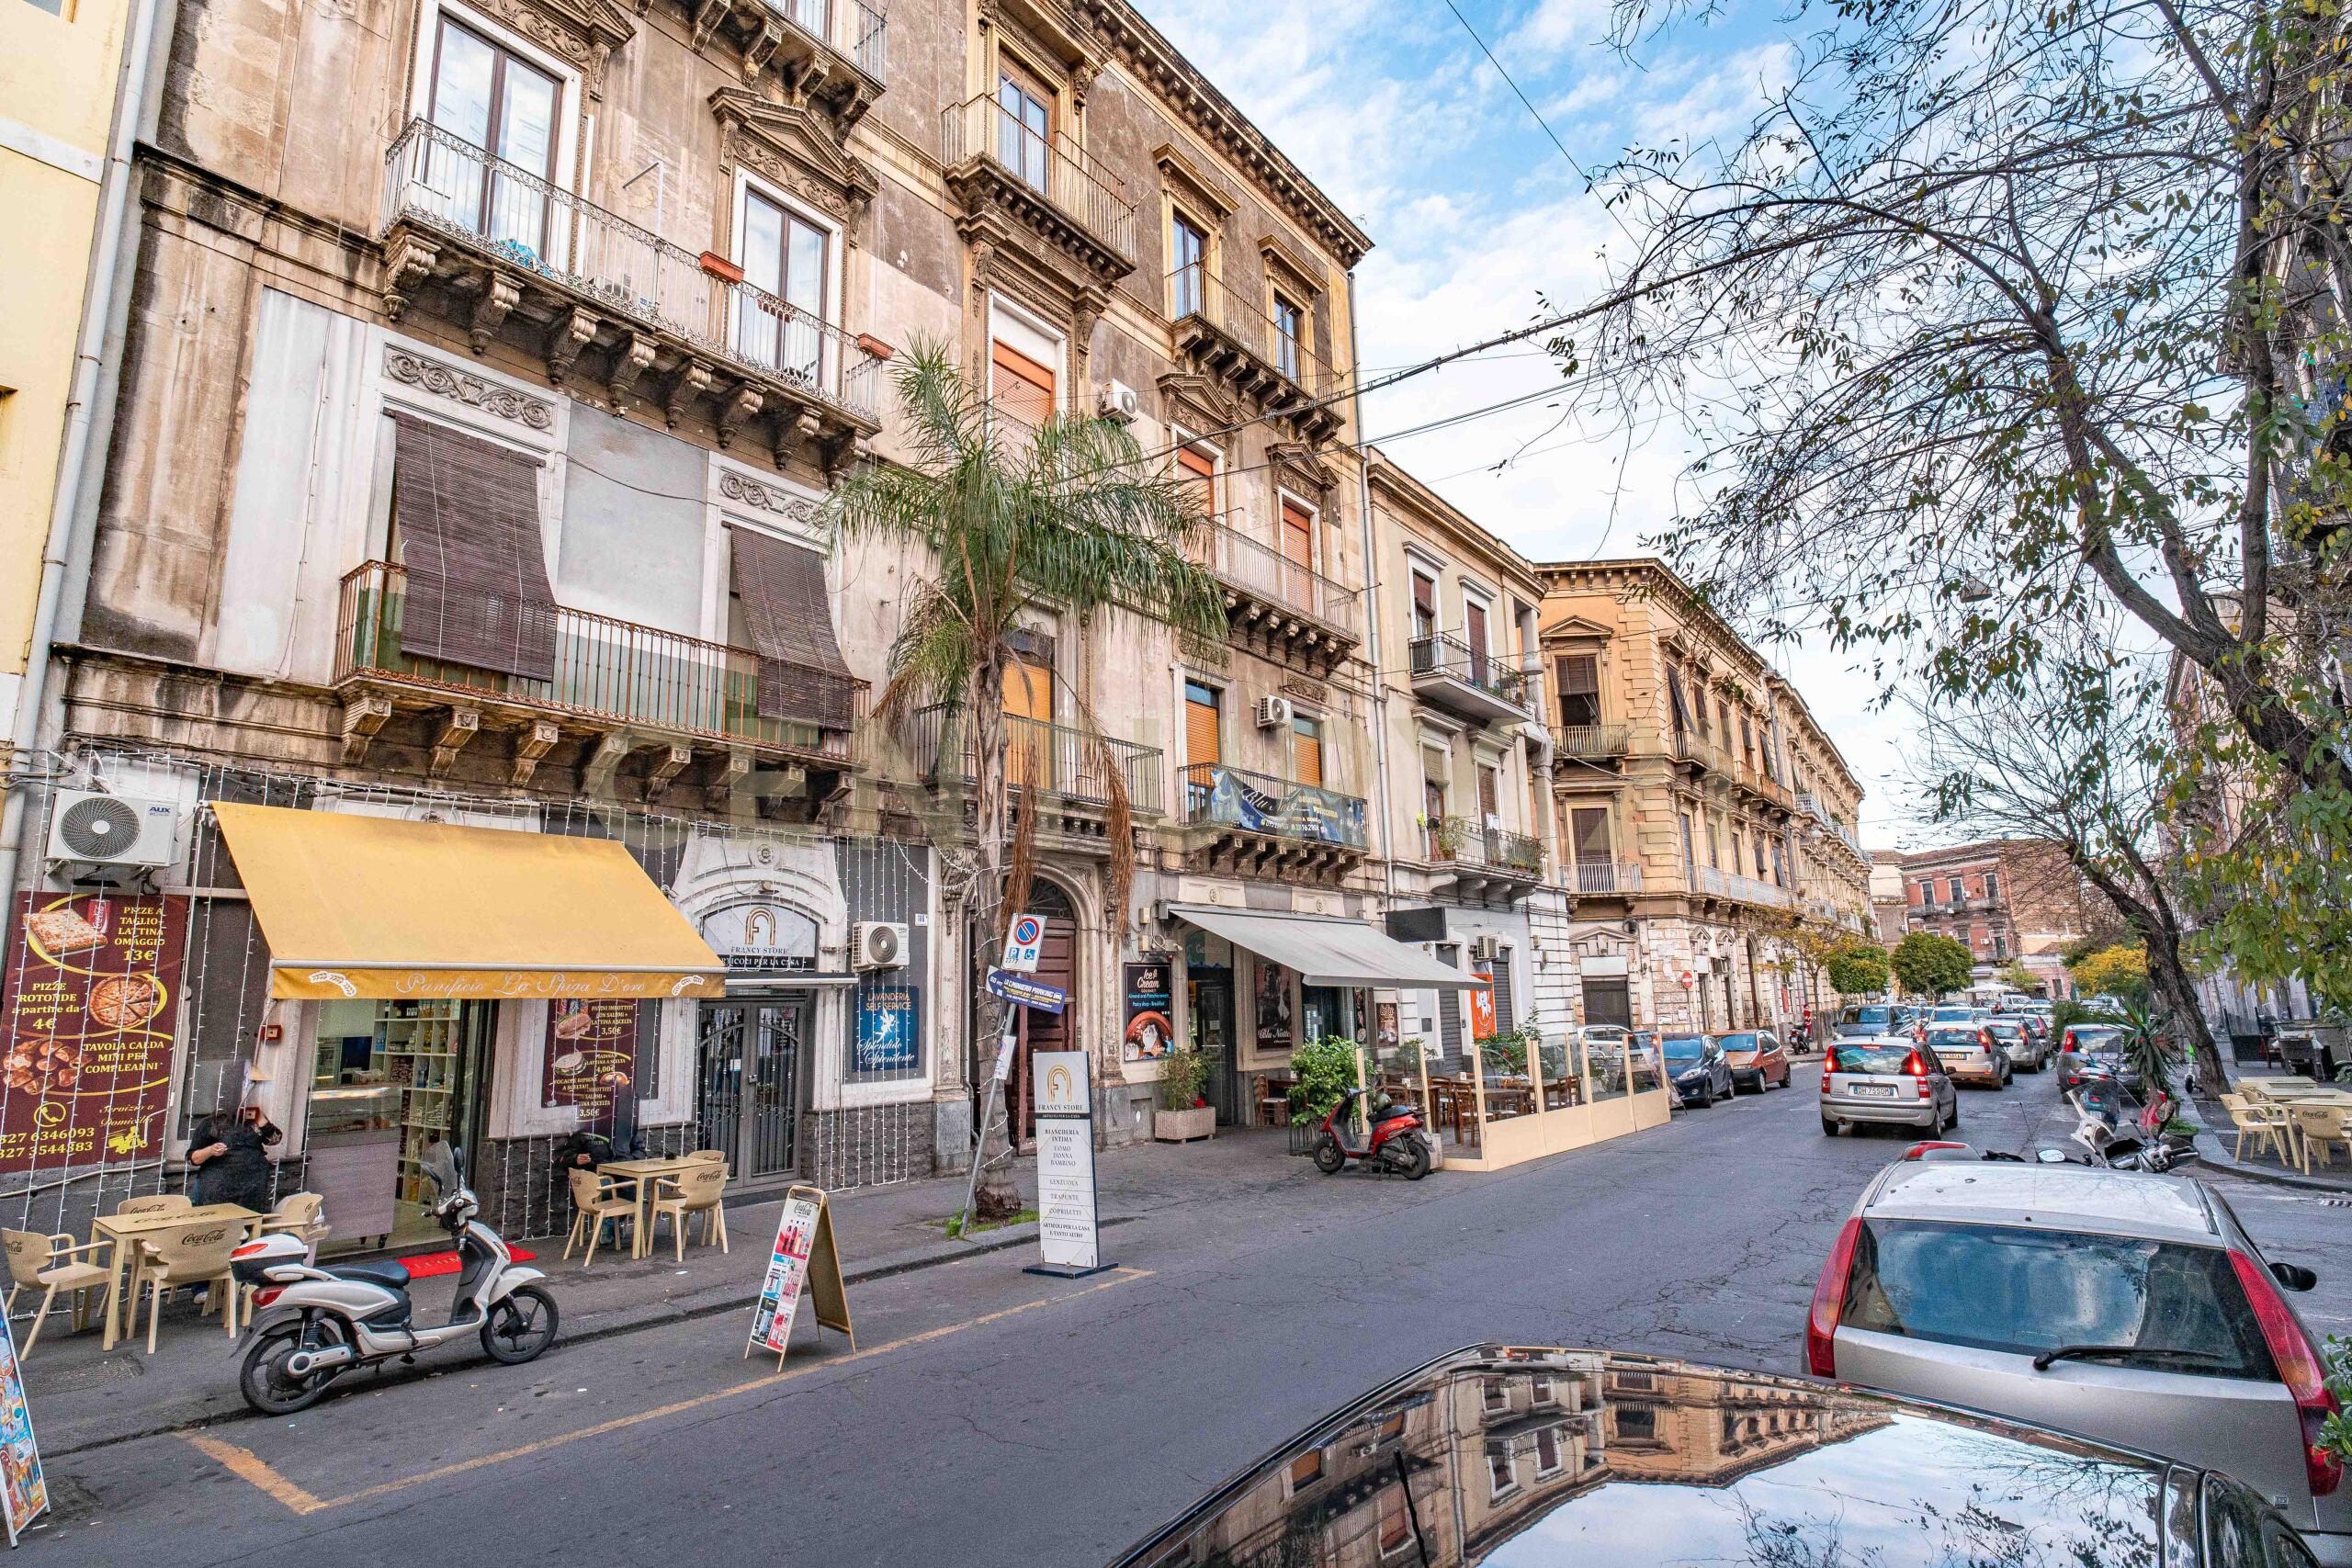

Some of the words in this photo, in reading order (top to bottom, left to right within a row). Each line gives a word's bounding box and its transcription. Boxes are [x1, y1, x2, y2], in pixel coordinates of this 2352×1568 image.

[123, 907, 154, 915] PIZZE
[119, 917, 158, 925] TAGLIO
[118, 928, 164, 936] LATTINA
[114, 938, 165, 946] OMAGGIO
[123, 950, 154, 961] 13€
[32, 983, 67, 991] PIZZE
[395, 972, 485, 998] Panificio
[493, 973, 529, 995] La
[537, 973, 590, 998] Spiga
[1137, 976, 1159, 988] Cream
[18, 994, 77, 1002] ROTONDE
[867, 992, 910, 1001] LAVANDERIA
[21, 1005, 63, 1016] partire
[65, 1005, 80, 1013] da
[865, 1002, 882, 1011] SELF
[884, 1001, 912, 1010] SERVICE
[33, 1018, 57, 1030] 4€
[84, 1043, 127, 1052] TAVOLA
[129, 1041, 164, 1050] CALDA
[97, 1054, 124, 1062] MINI
[126, 1052, 148, 1061] PER
[85, 1062, 158, 1074] COMPLEANNI
[696, 1169, 723, 1183] Coca-Cola
[794, 1201, 813, 1216] Coca-Cola
[181, 1228, 229, 1246] Coca-Cola
